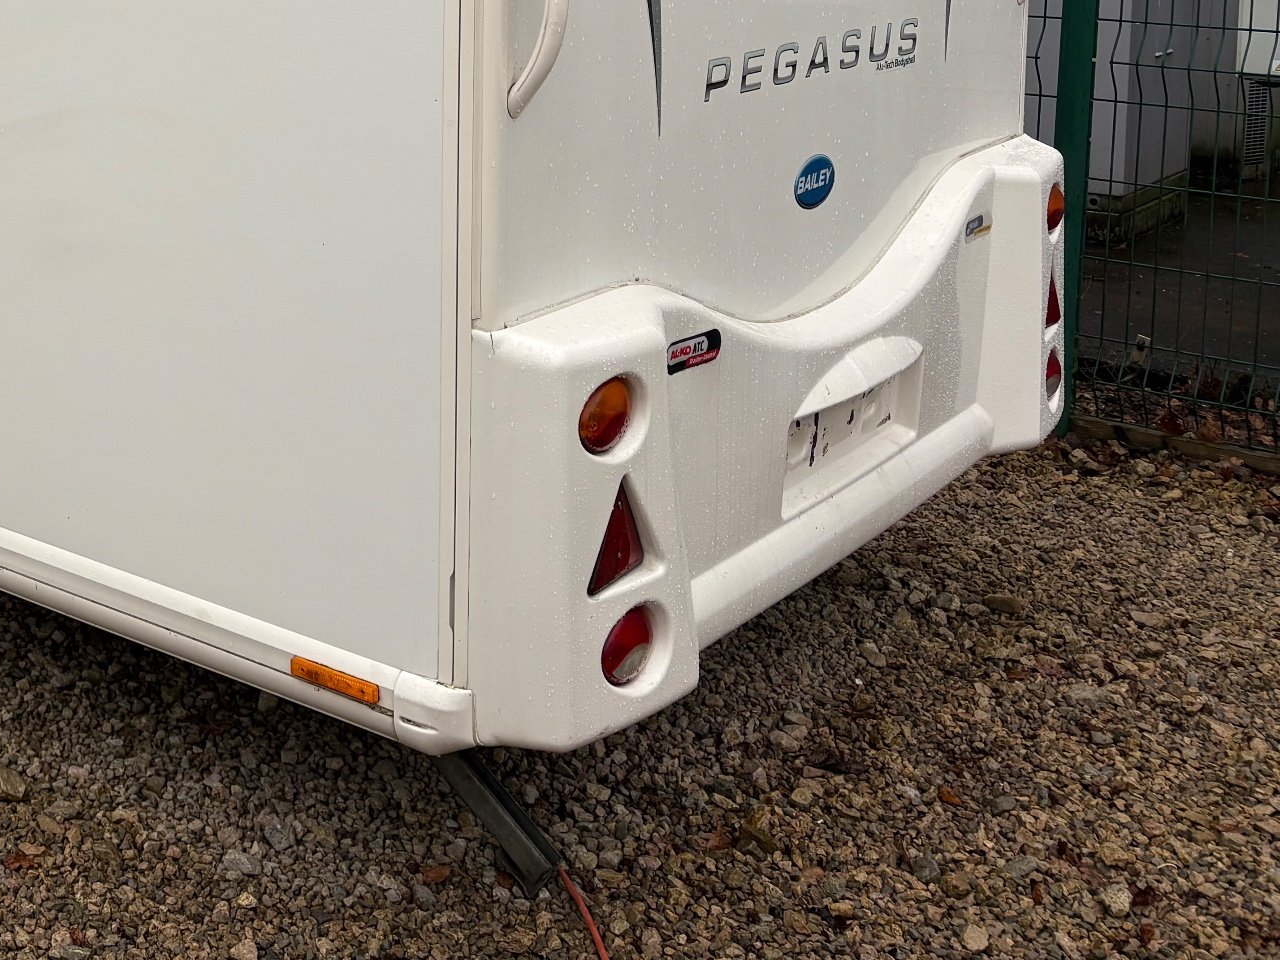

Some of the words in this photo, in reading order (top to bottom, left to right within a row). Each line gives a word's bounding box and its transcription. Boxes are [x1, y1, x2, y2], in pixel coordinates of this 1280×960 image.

[704, 17, 919, 103] PEGASUS
[797, 166, 833, 195] BAILEY
[692, 340, 705, 355] ATC
